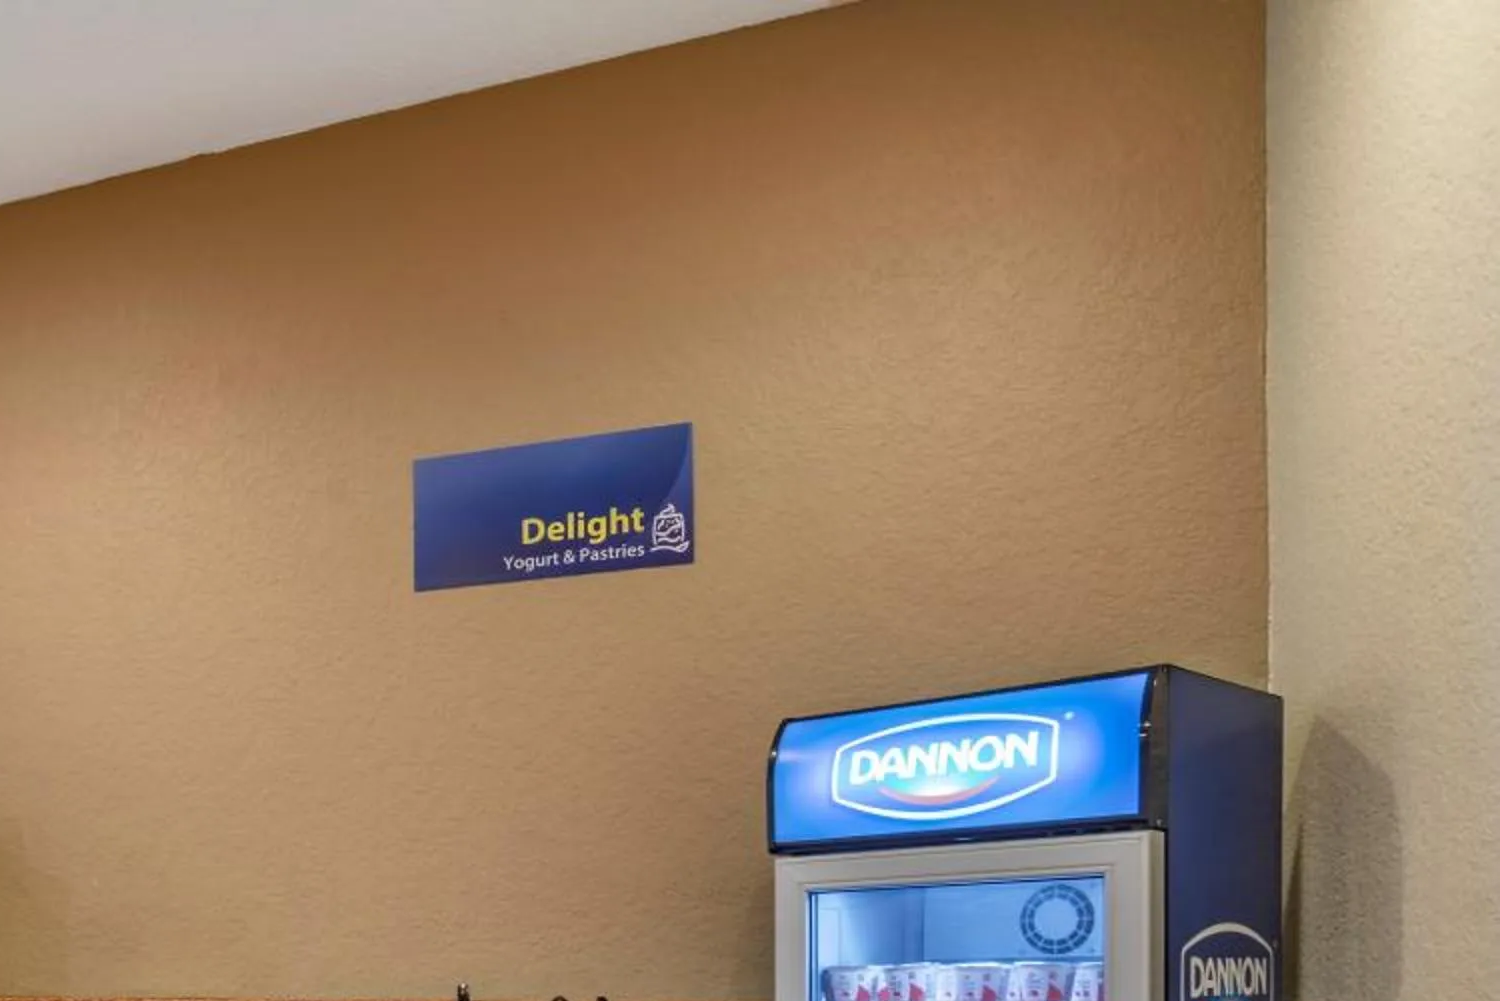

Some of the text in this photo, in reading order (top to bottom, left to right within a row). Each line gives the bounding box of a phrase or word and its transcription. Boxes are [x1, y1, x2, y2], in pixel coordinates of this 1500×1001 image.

[522, 507, 645, 545] Delight
[503, 544, 645, 573] Yogurt & Pastries
[850, 730, 1039, 785] DANNON
[1190, 956, 1267, 999] DANNON
